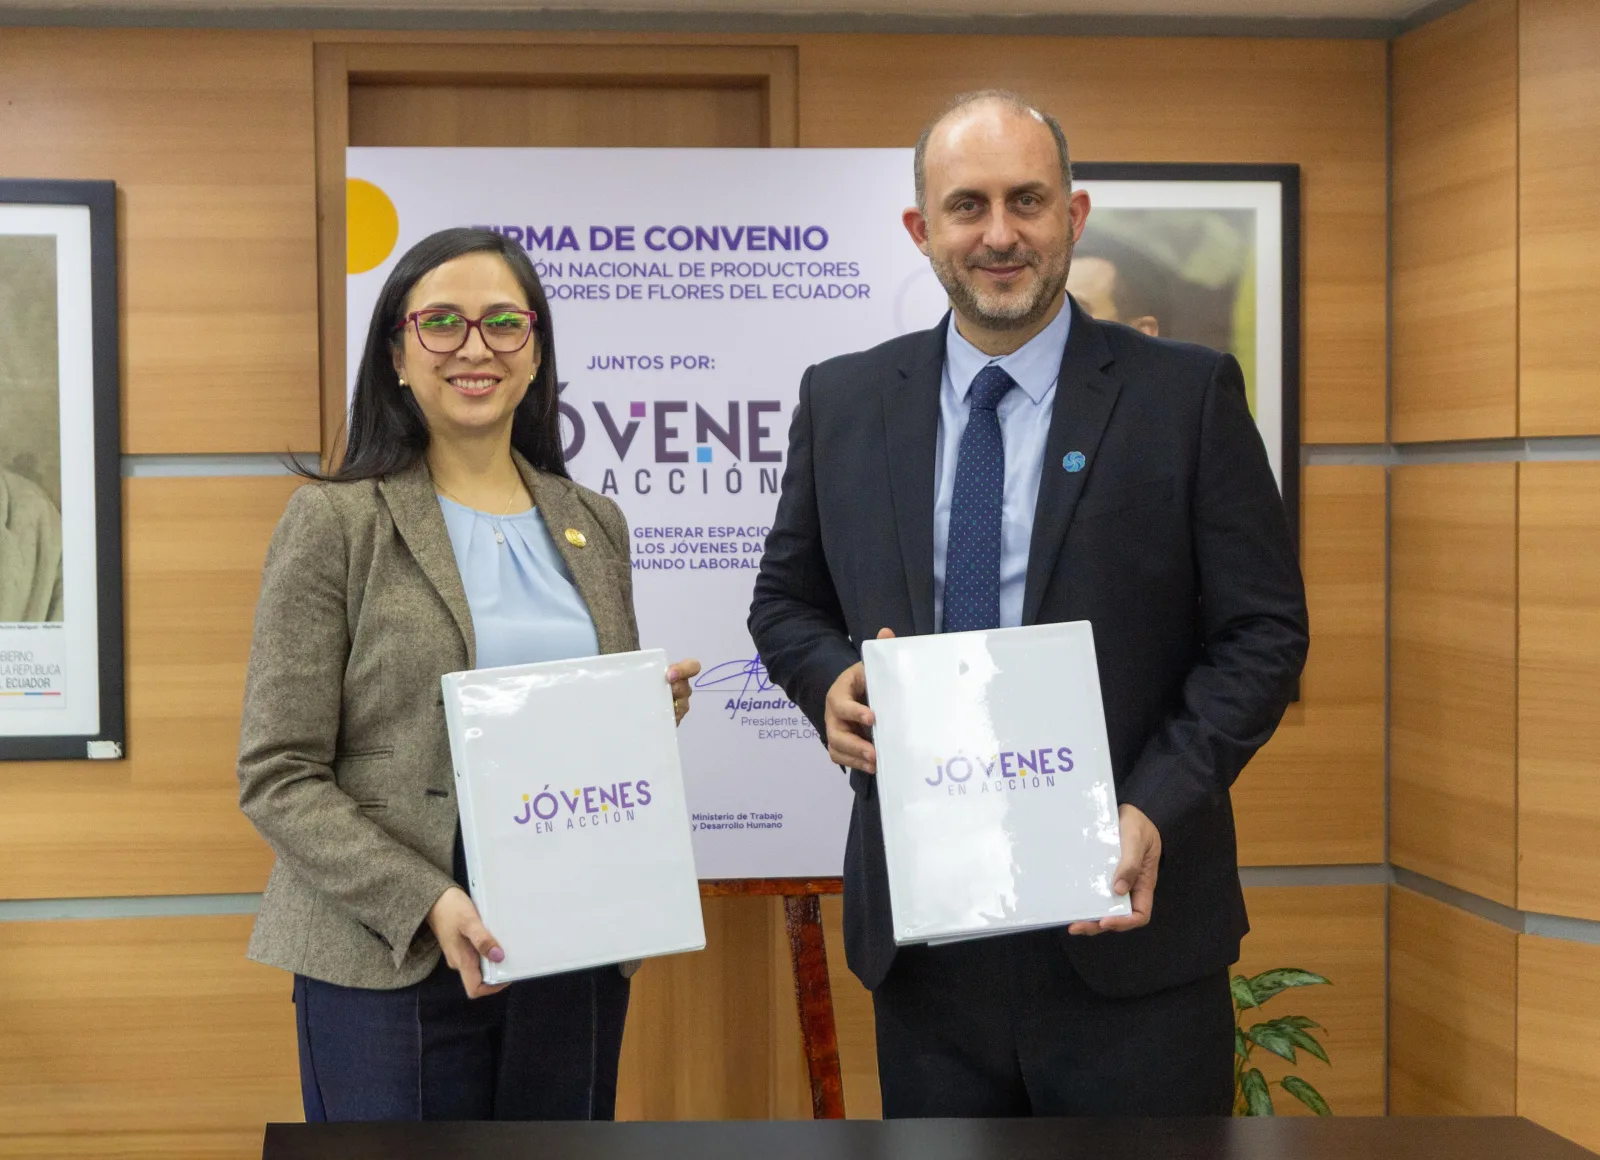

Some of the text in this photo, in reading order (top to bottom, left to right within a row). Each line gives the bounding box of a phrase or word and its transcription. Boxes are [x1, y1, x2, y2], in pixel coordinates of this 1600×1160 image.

[472, 225, 829, 251] RMA DE CONVENIO
[569, 262, 673, 277] NACIONAL
[679, 262, 705, 277] DE
[711, 262, 860, 277] PRODUCTORES
[616, 284, 642, 300] DE
[648, 284, 724, 300] FLORES
[730, 284, 767, 300] DEL
[773, 284, 871, 300] ECUADOR
[587, 355, 717, 370] JUNTOS POR:
[557, 381, 800, 463] VENE
[601, 462, 778, 495] ACCIÓN
[634, 526, 771, 539] GENERAR ESPACIO
[637, 540, 766, 554] LOS JÓVENES DA
[631, 558, 760, 569] MUNDO LABORAL
[6, 677, 51, 688] ECUADOR
[725, 697, 796, 711] Alejandro
[741, 716, 798, 726] Presidente
[925, 747, 1074, 786] JÓVENES
[948, 774, 1055, 796] EN ACCIÓN
[513, 780, 652, 825] JÓVENES
[535, 809, 635, 834] EN ACCIÓN
[692, 812, 783, 821] Ministerio de Trabajo
[700, 821, 744, 830] Desarrollo
[747, 821, 783, 829] Humano
